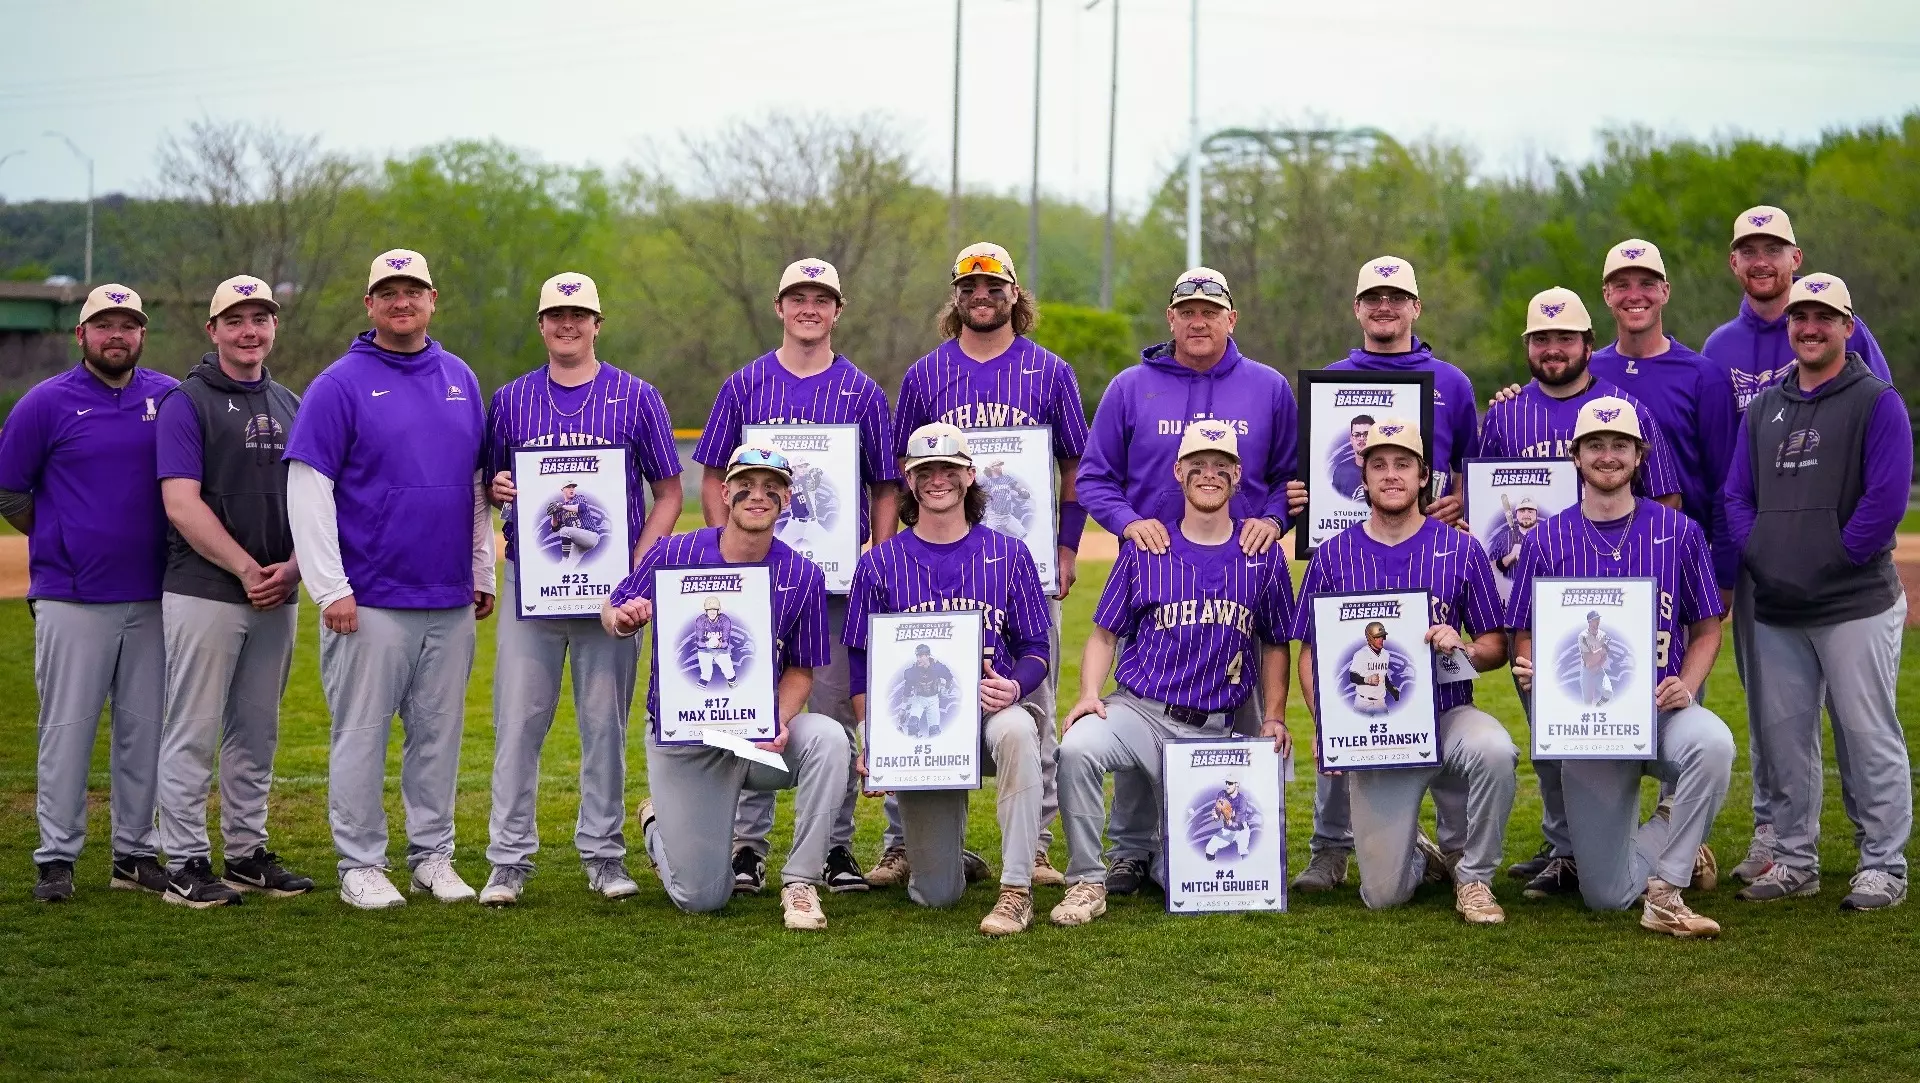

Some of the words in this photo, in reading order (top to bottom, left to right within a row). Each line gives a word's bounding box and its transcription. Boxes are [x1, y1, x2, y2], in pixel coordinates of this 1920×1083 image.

[1626, 361, 1639, 374] L
[1336, 395, 1392, 406] BASEBALL
[774, 439, 828, 450] BASEBALL
[969, 442, 1021, 453] BASEBALL
[541, 462, 597, 474] BASEBALL
[1493, 473, 1549, 485] BASEBALL
[561, 573, 589, 584] #23
[540, 585, 571, 597] MATT
[575, 584, 611, 596] JETER
[683, 580, 741, 593] BASEBALL
[1563, 593, 1622, 605] BASEBALL
[1341, 606, 1399, 620] BASEBALL
[897, 628, 951, 640] BASEBALL
[1657, 630, 1672, 668] 3
[1227, 650, 1243, 685] 4
[704, 697, 730, 709] #17
[678, 709, 706, 722] MAX
[710, 708, 756, 721] CULLEN
[1580, 712, 1607, 723] #13
[1369, 723, 1388, 734] #3
[1548, 724, 1589, 736] ETHAN
[1593, 724, 1640, 736] PETERS
[1329, 735, 1368, 749] TYLER
[1371, 732, 1429, 747] PRANSKY
[914, 744, 932, 755] #5
[875, 756, 921, 768] DAKOTA
[924, 754, 970, 767] CHURCH
[1192, 754, 1249, 767] BASEBALL
[1350, 754, 1376, 762] CLASS
[1215, 869, 1235, 880] #4
[1181, 881, 1219, 893] MITCH
[1222, 880, 1269, 892] GRUBER
